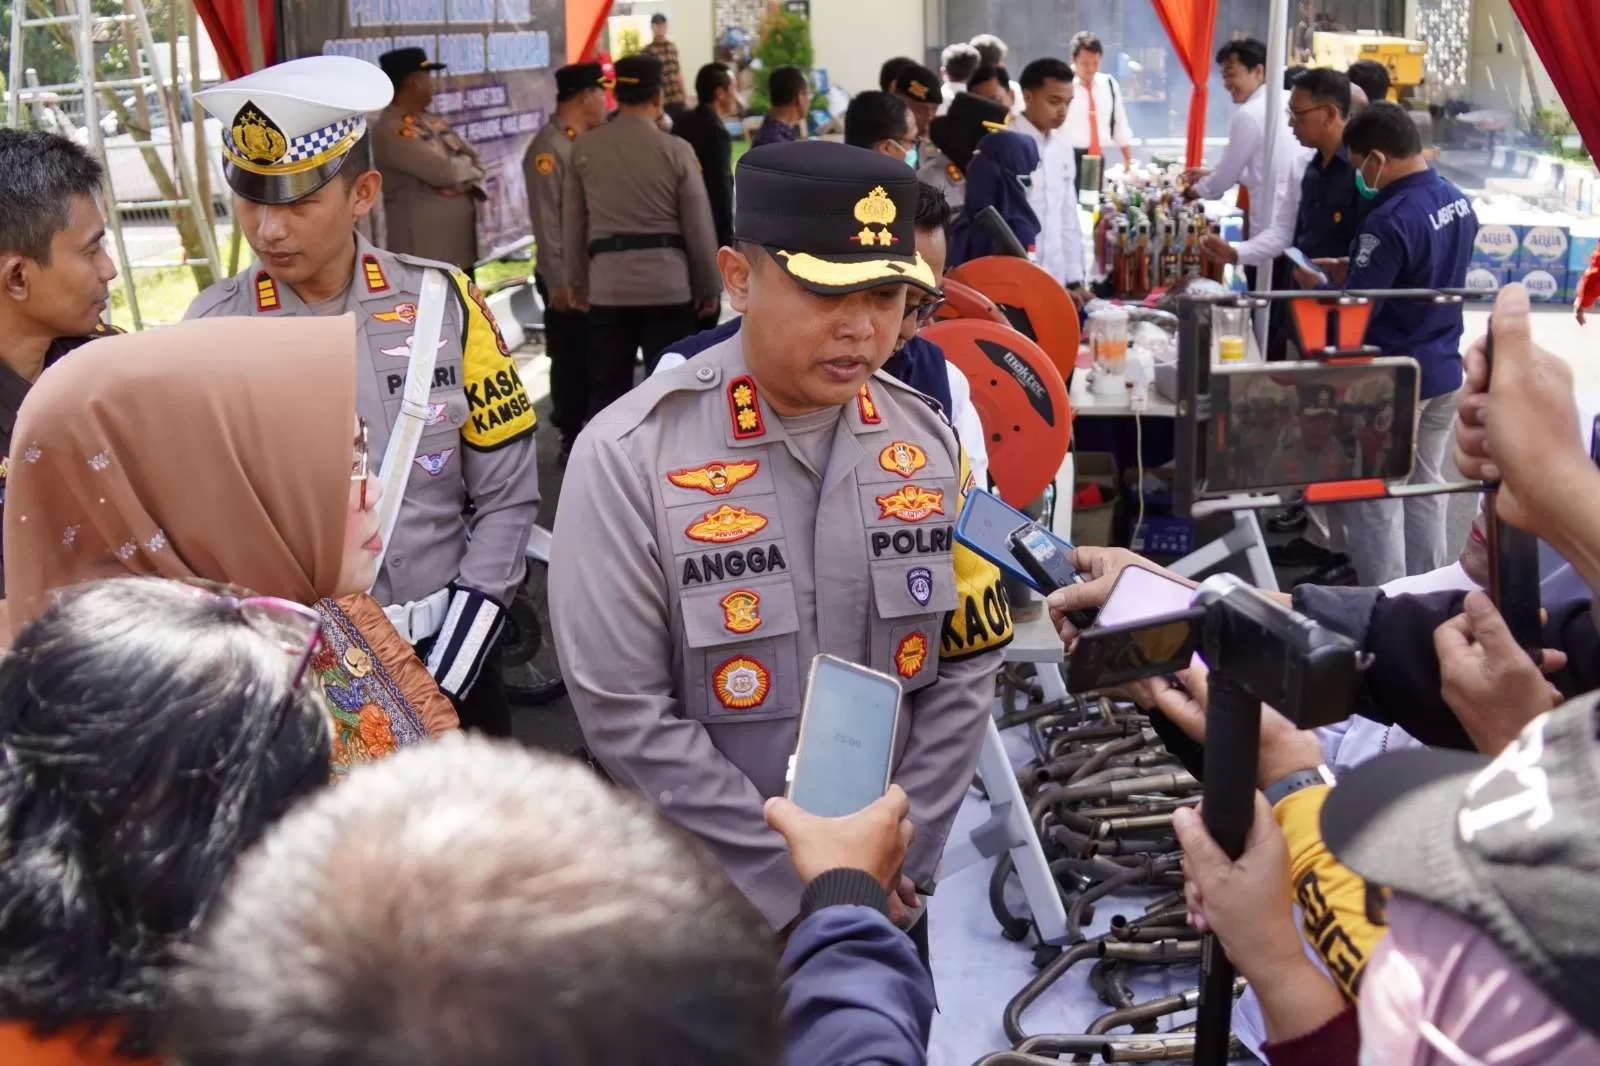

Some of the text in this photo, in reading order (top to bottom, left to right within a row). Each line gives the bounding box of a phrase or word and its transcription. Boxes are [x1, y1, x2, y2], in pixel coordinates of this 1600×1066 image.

[1429, 198, 1470, 230] LABFOR
[1482, 232, 1512, 246] AQUA
[1530, 234, 1561, 248] AQUA
[387, 366, 457, 395] PRI
[871, 524, 954, 557] POLRI
[682, 543, 787, 586] ANGGA
